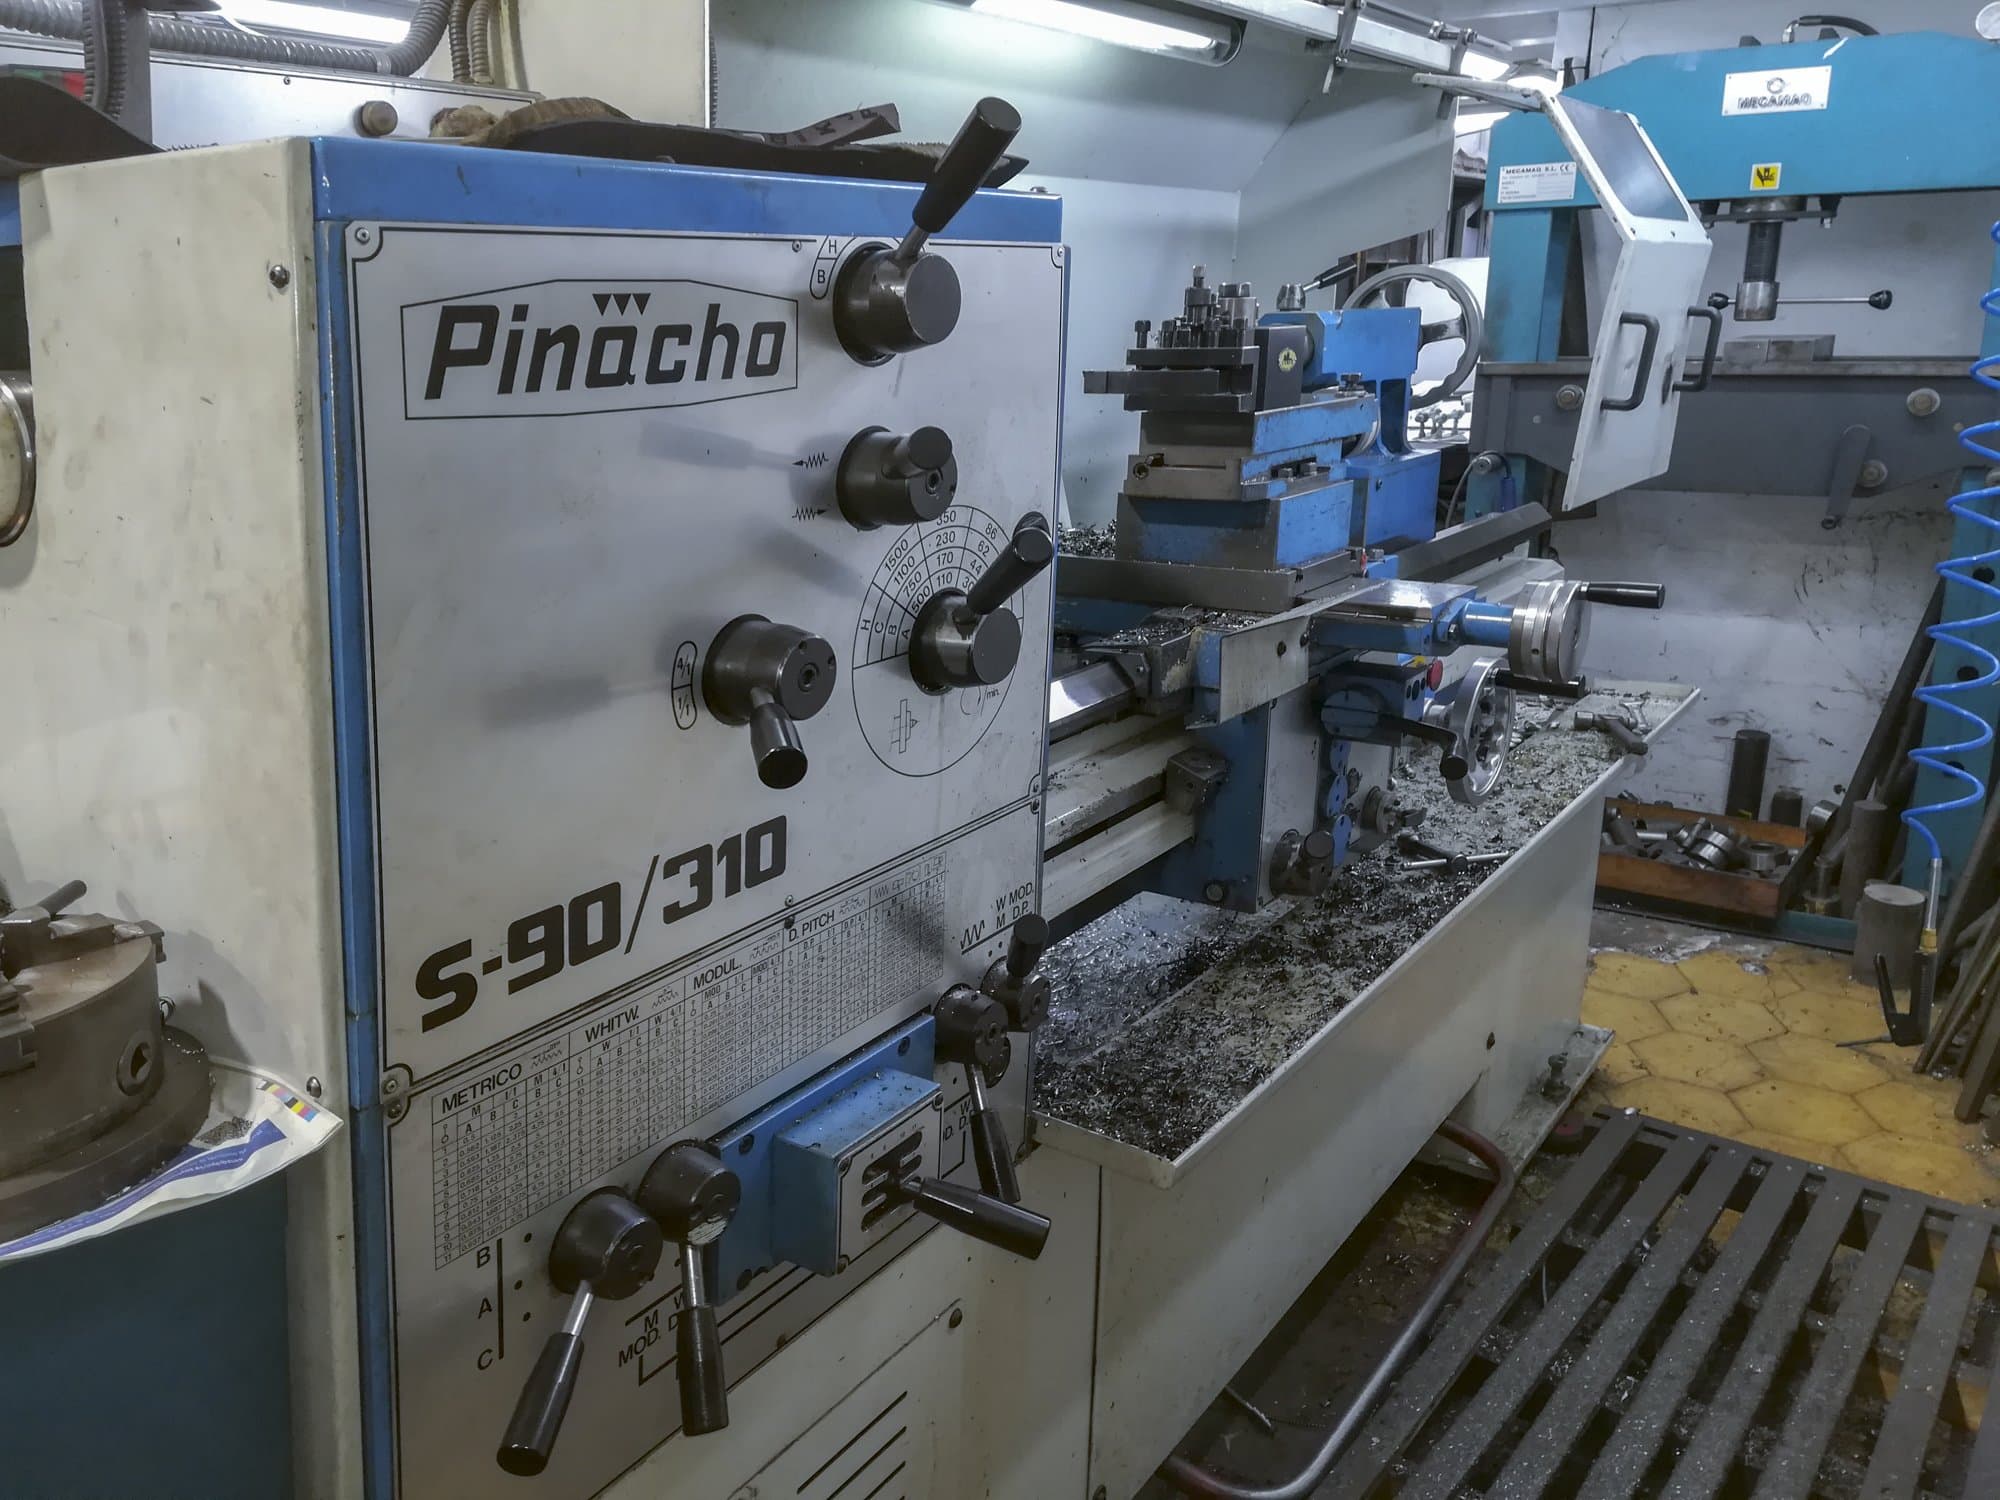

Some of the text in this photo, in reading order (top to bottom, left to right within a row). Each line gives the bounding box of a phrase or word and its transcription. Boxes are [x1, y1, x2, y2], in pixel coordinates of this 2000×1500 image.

[829, 239, 838, 254] H
[817, 269, 826, 284] B
[425, 303, 786, 401] Pinacho
[935, 530, 956, 547] 230
[985, 522, 998, 541] 86
[884, 538, 908, 573] 1500
[937, 551, 954, 567] 170
[977, 540, 990, 557] 62
[894, 555, 916, 586] 1100
[936, 571, 953, 587] 110
[970, 559, 982, 576] 44
[903, 571, 922, 598] 750
[911, 584, 931, 614] 500
[861, 619, 871, 631] H
[874, 622, 884, 633] C
[888, 624, 897, 636] B
[902, 627, 911, 640] A
[996, 882, 1034, 913] W MOD.
[415, 814, 788, 1034] S-90/310
[789, 909, 835, 942] D. PITCH
[996, 913, 1006, 930] M
[693, 958, 742, 990] MODUL.
[585, 1005, 639, 1043] WHITW.
[597, 1057, 603, 1067] A
[617, 1047, 623, 1057] B
[636, 1037, 642, 1047] C
[602, 1040, 611, 1051] W
[442, 1063, 522, 1114] METRICO
[472, 1104, 481, 1117] M
[534, 1074, 543, 1086] M
[465, 1077, 562, 1134] A B C B C
[477, 1246, 491, 1268] B
[478, 1297, 492, 1320] A
[644, 1308, 659, 1333] M
[618, 1328, 661, 1368] MOD.
[477, 1349, 493, 1371] C
